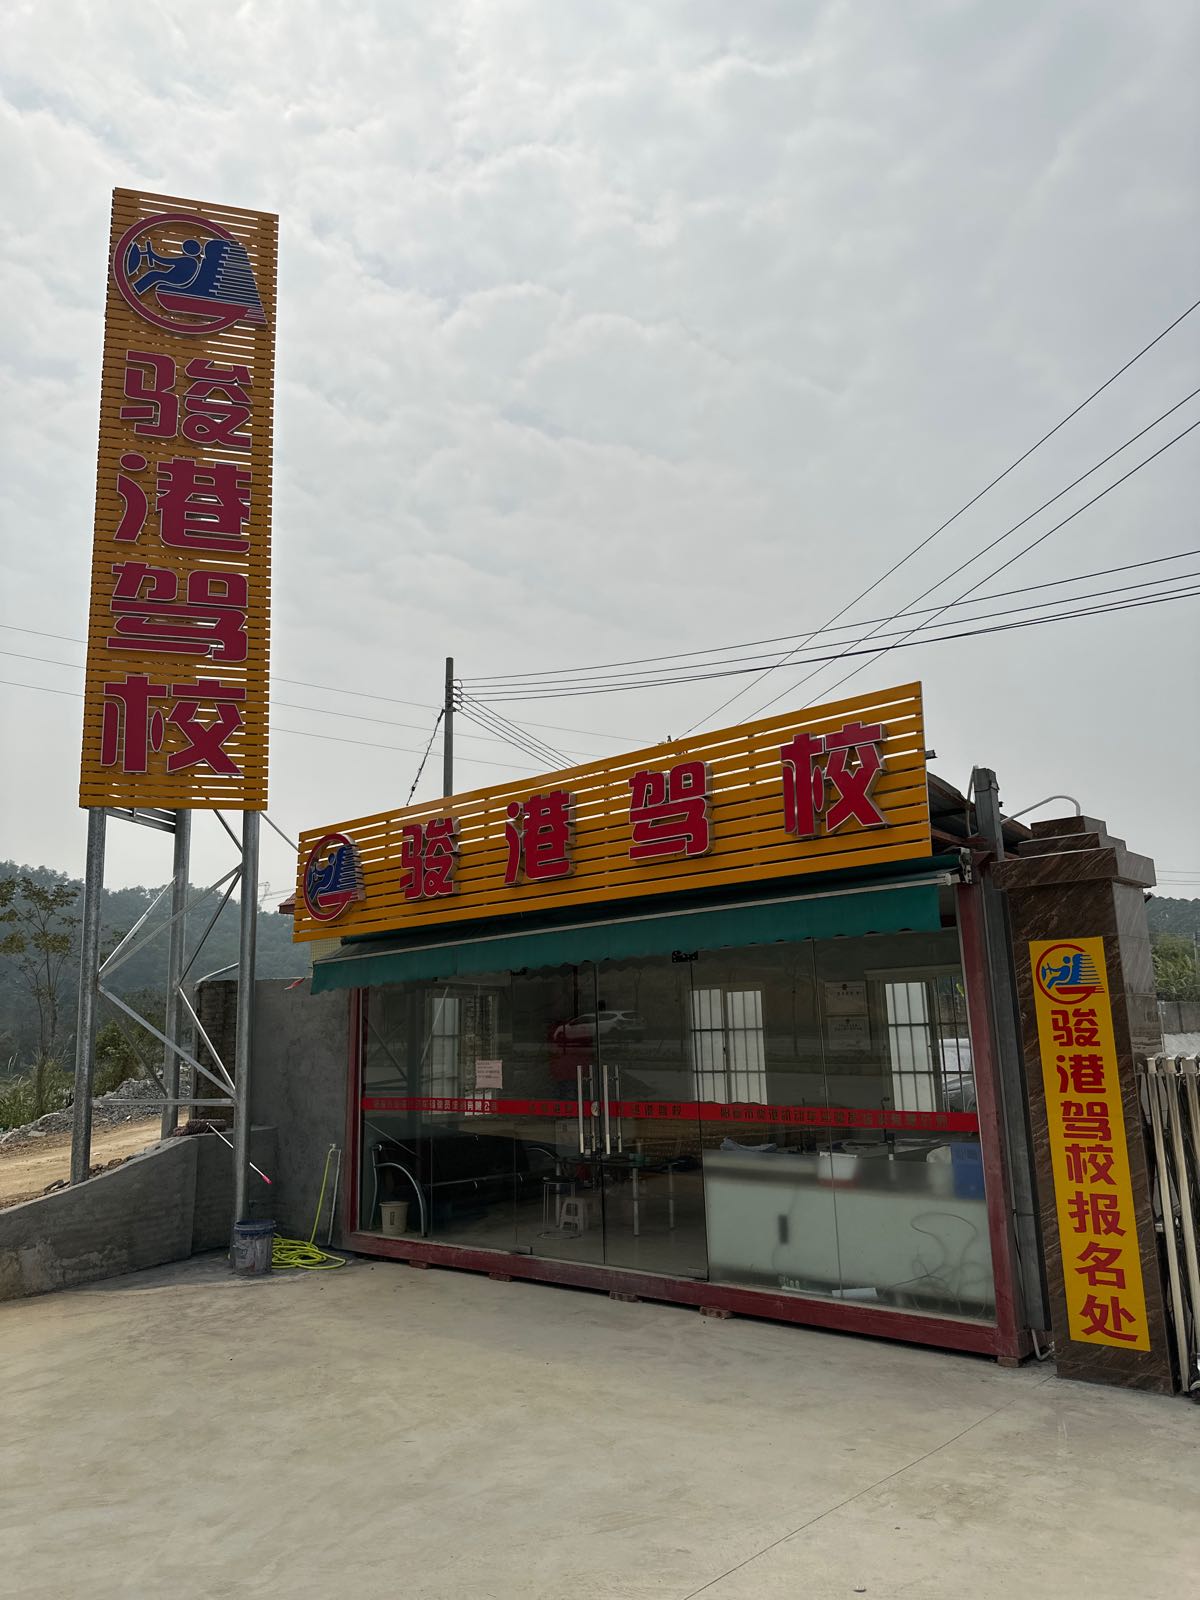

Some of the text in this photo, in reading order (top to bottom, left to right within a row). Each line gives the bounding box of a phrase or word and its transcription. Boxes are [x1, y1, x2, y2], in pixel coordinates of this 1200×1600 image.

[100, 349, 254, 775] 骏港驾校
[400, 720, 890, 902] 骏港驾校
[1050, 1007, 1139, 1343] 骏港驾校报名处
